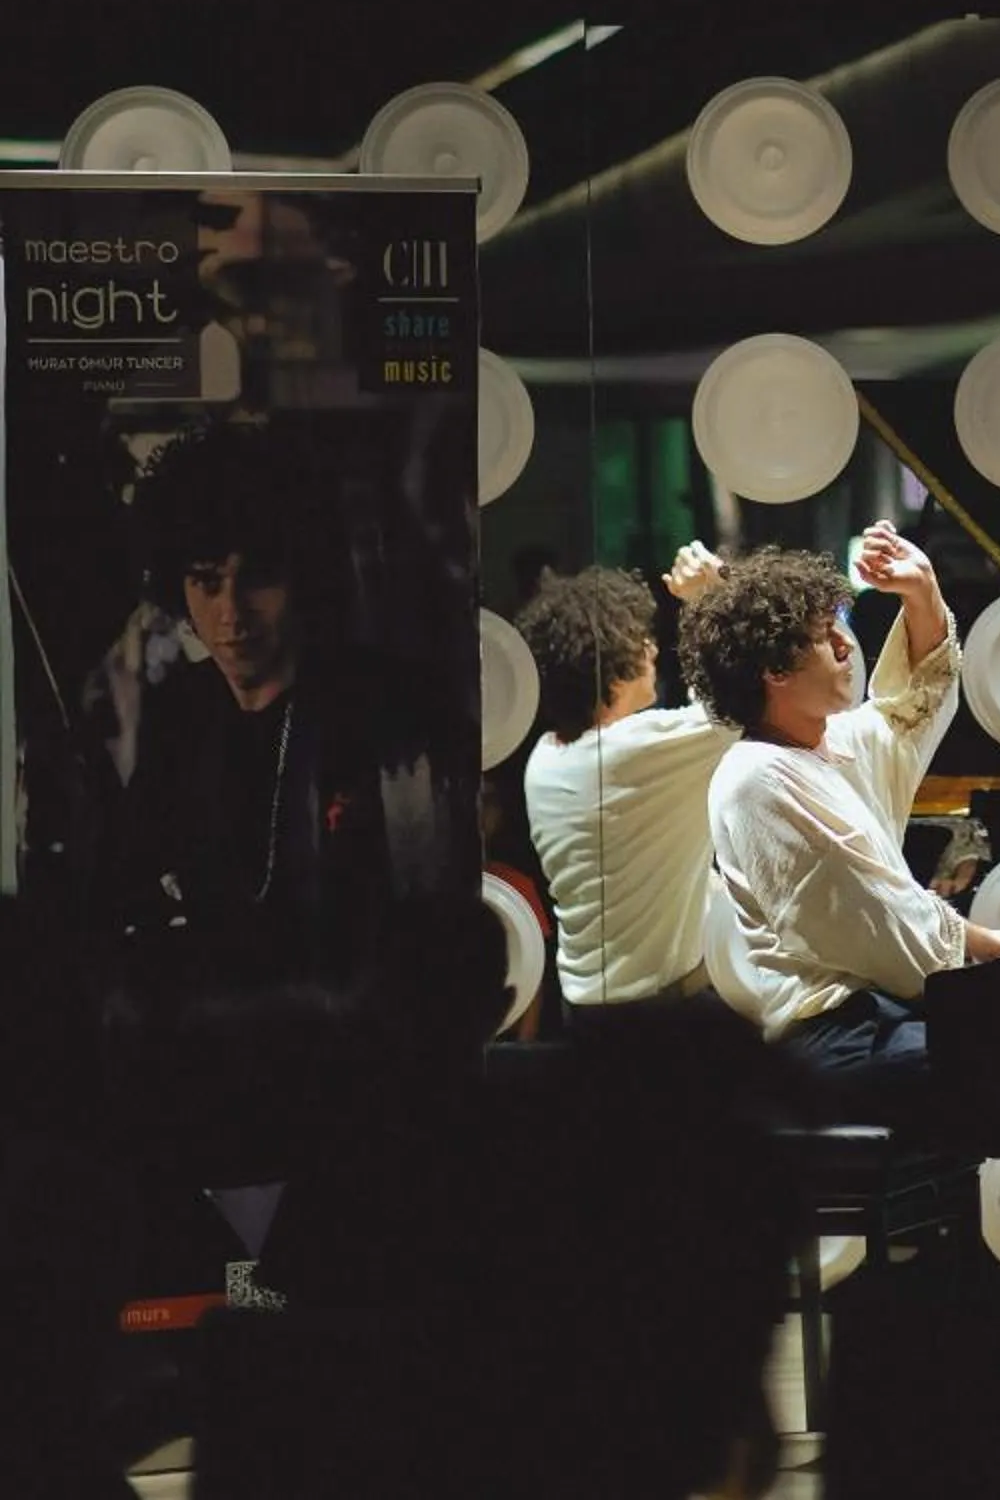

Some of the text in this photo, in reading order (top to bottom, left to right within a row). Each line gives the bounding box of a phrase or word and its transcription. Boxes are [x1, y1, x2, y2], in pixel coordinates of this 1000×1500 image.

[25, 237, 179, 263] maestro
[27, 280, 178, 329] night
[383, 309, 450, 338] share
[126, 356, 183, 370] TUNCER
[384, 355, 453, 382] music
